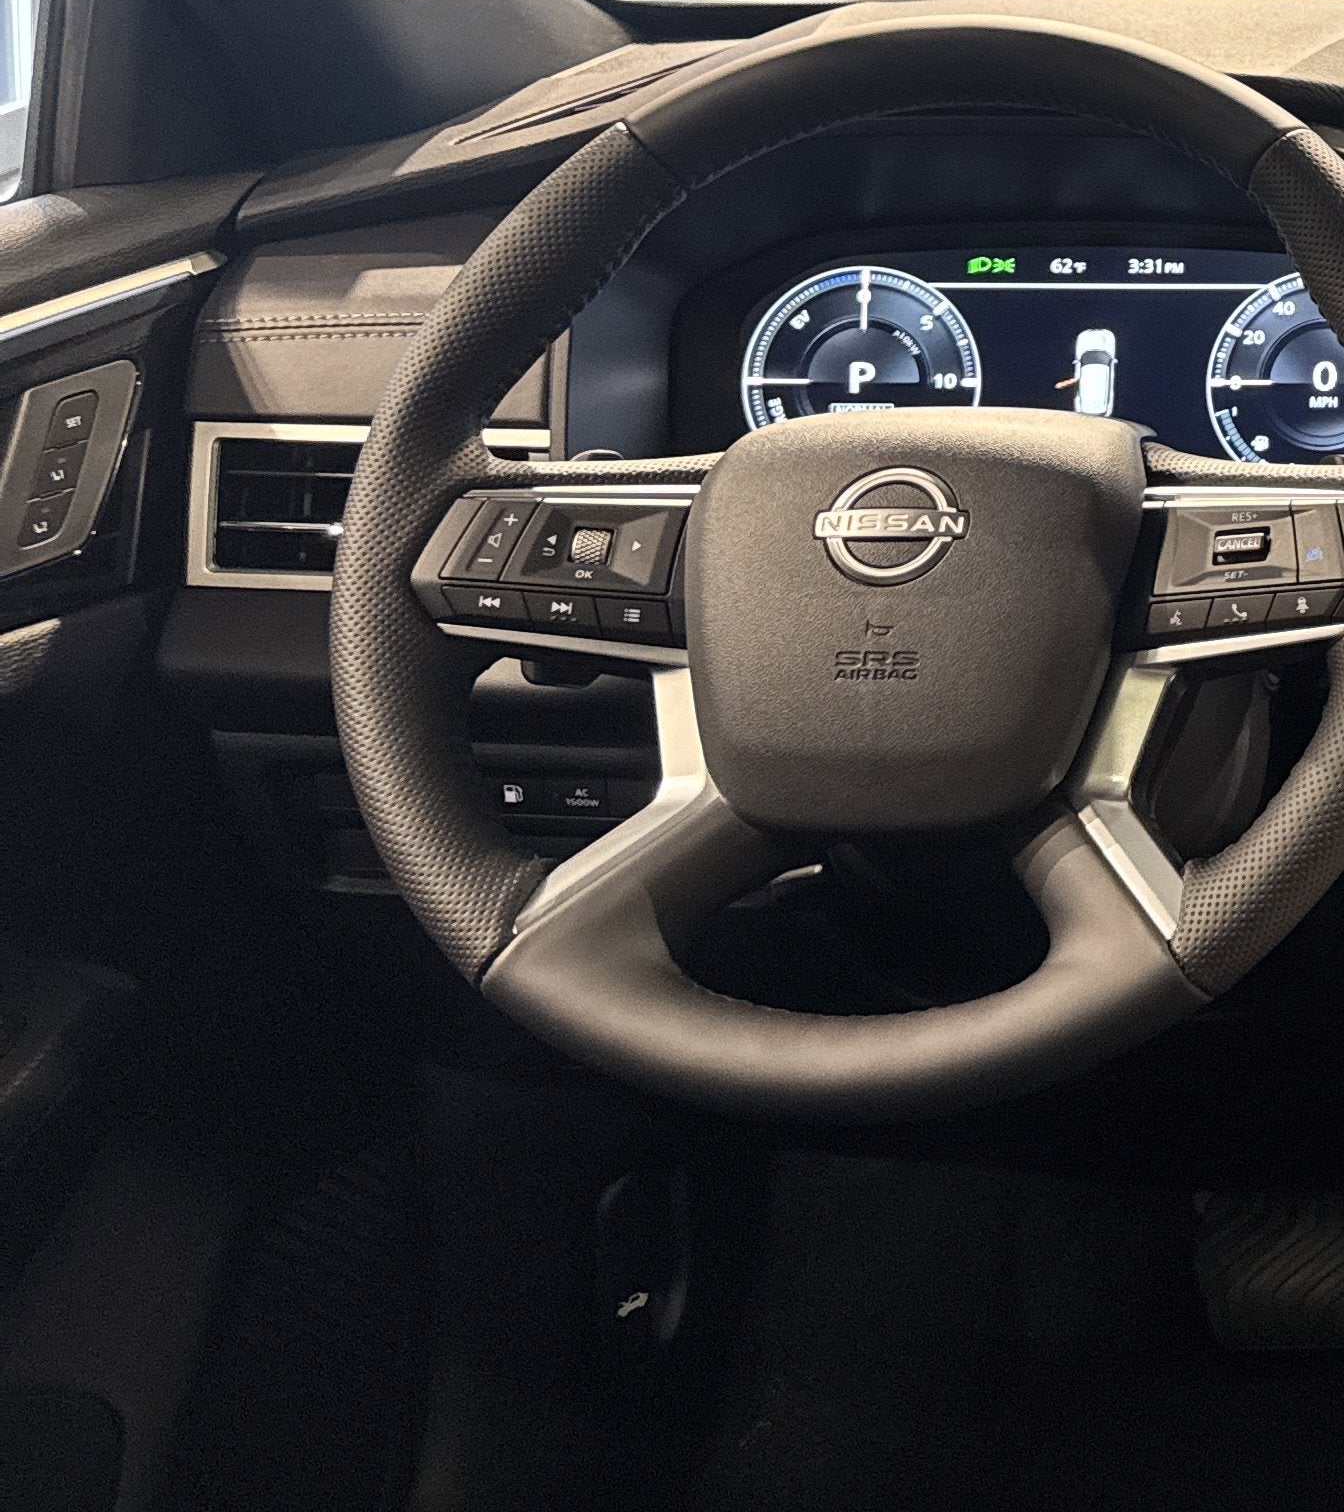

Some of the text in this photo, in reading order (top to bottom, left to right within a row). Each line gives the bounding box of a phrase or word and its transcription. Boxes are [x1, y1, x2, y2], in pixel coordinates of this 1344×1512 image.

[1272, 301, 1296, 316] 40
[789, 309, 811, 330] EV
[1243, 330, 1266, 345] 20
[849, 362, 876, 394] P
[933, 373, 958, 389] 10
[1312, 361, 1338, 392] 0
[1309, 396, 1339, 409] MPH
[65, 415, 81, 429] SET
[821, 514, 965, 534] NISSAN
[1231, 512, 1258, 522] RES+
[1217, 537, 1260, 551] CANCEL
[575, 569, 594, 579] OK
[835, 651, 920, 667] SRS
[834, 669, 918, 681] AIRBAG
[575, 789, 589, 797] AC
